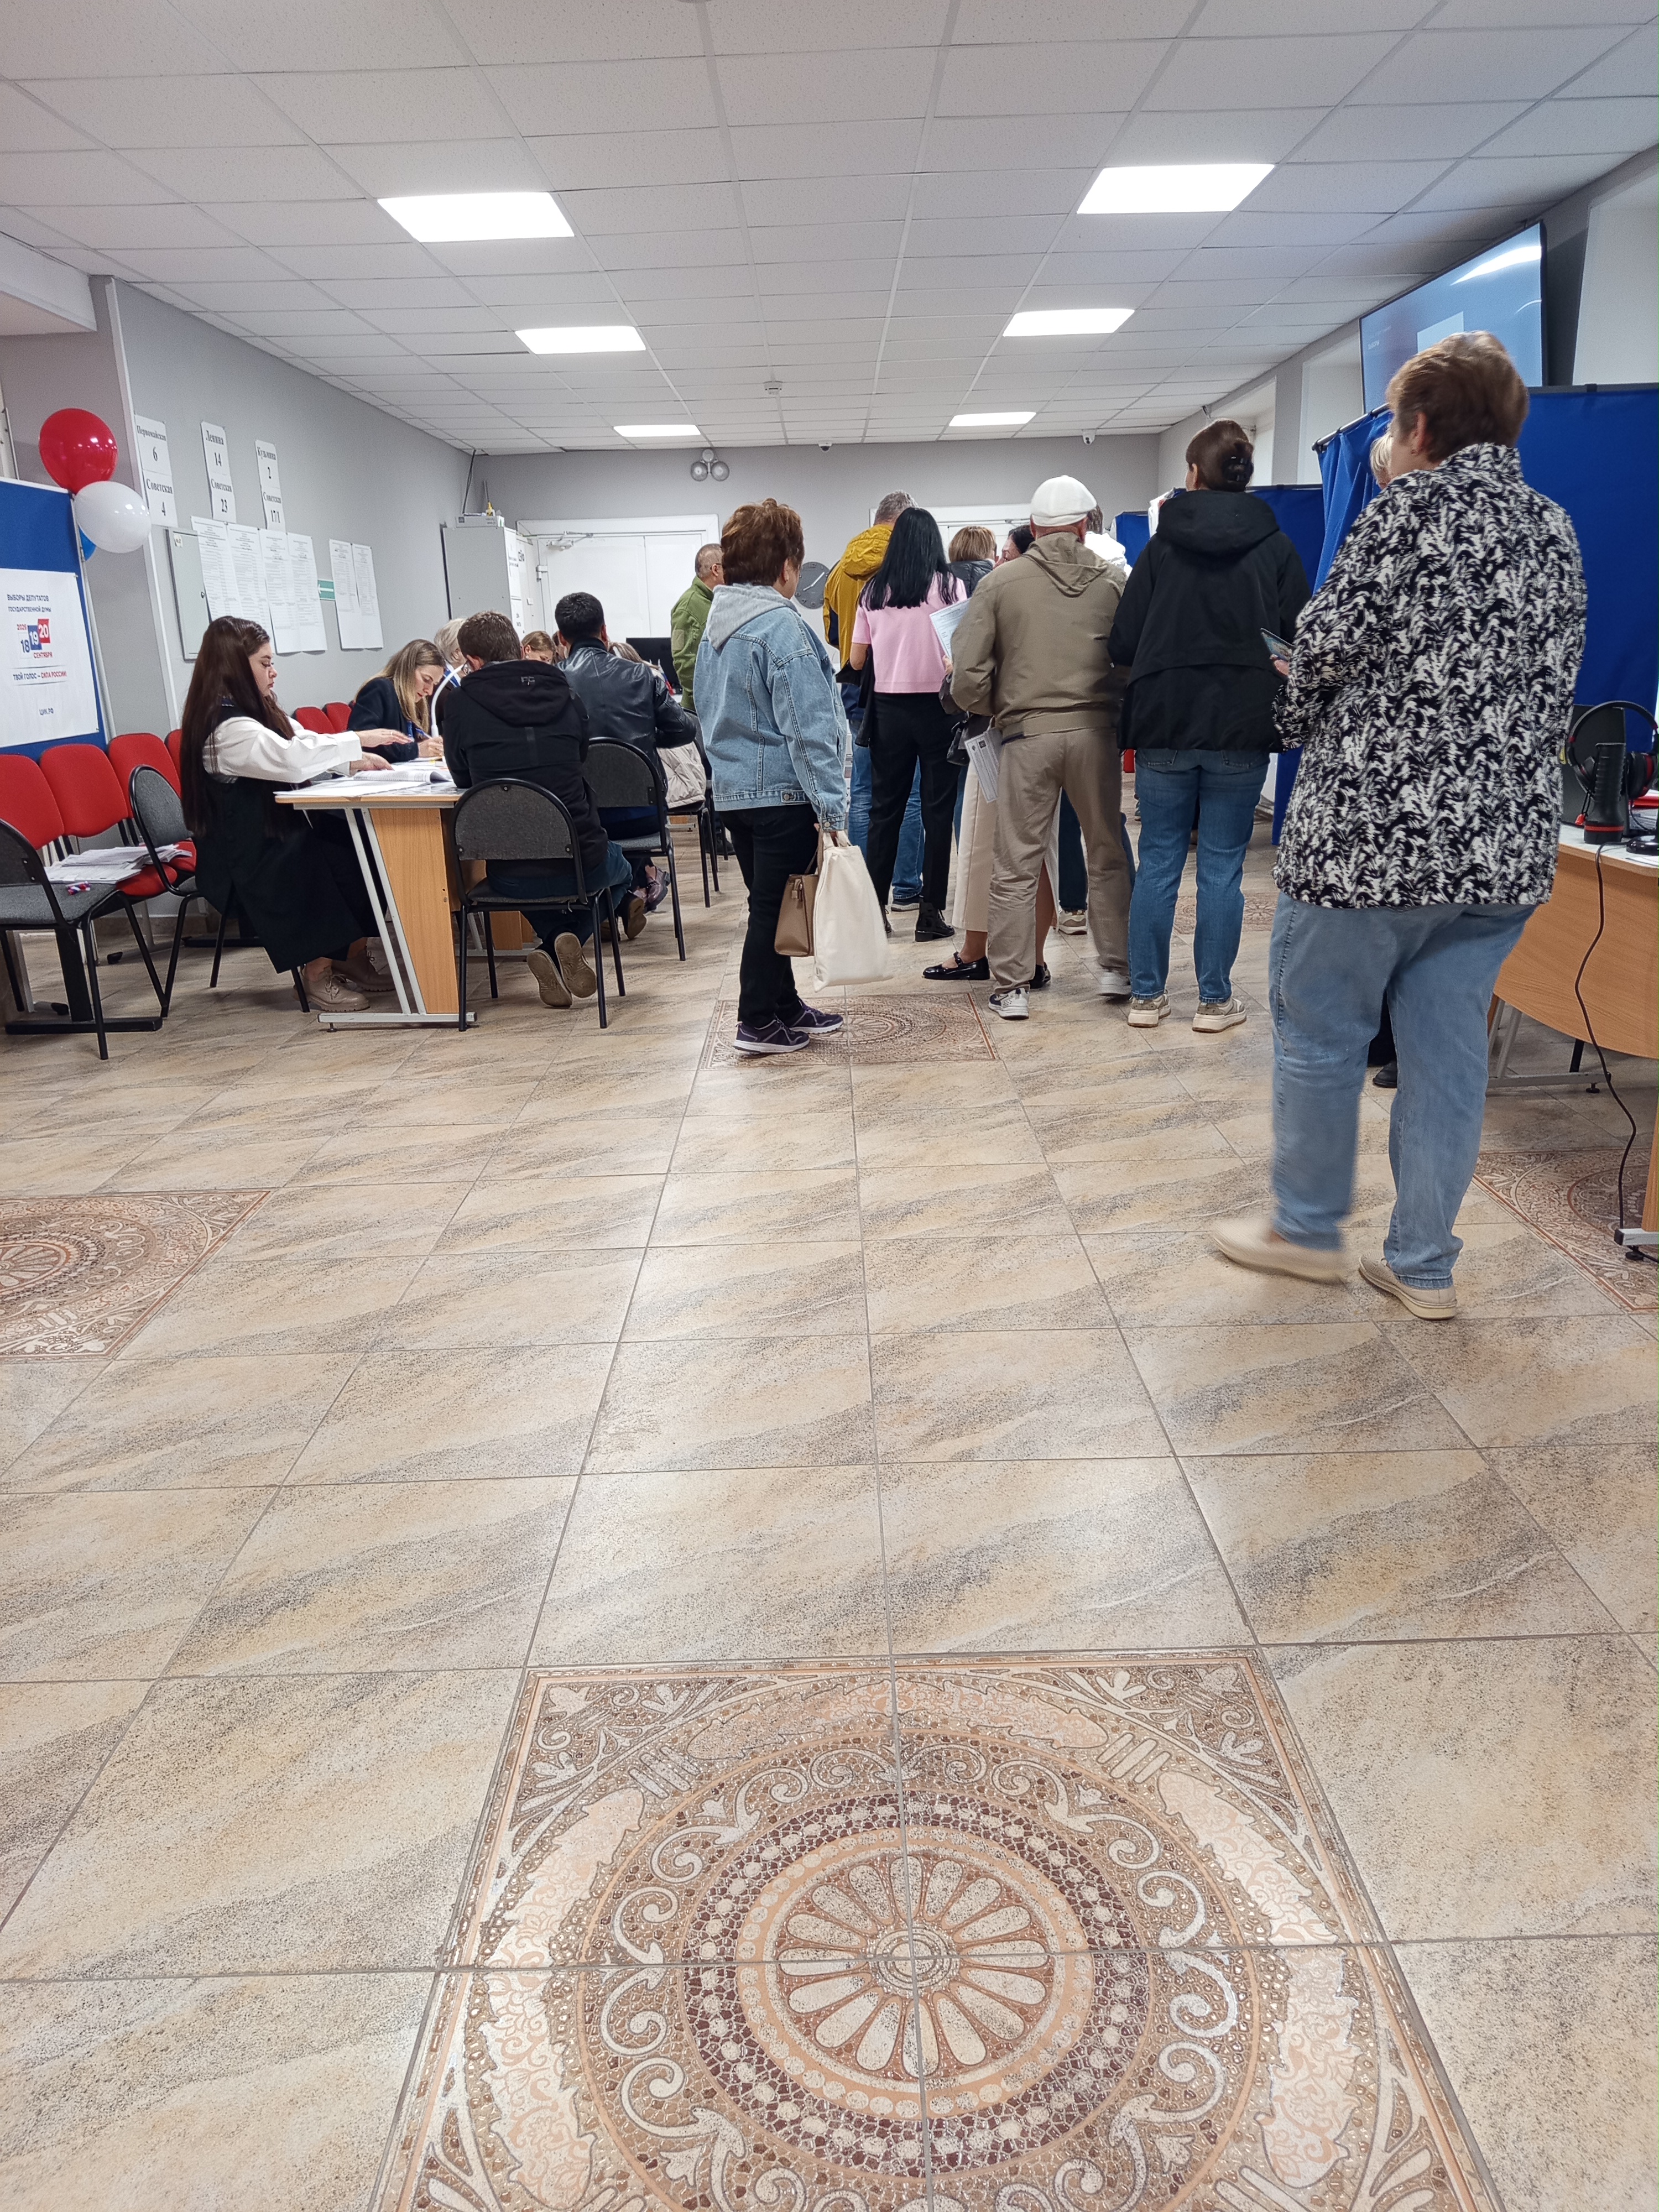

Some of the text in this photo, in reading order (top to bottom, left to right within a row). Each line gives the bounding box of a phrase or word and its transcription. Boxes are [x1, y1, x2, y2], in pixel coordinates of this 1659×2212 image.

[137, 425, 166, 441] Первомайская
[206, 430, 224, 445] Ленина
[153, 446, 158, 462] 6
[214, 452, 222, 467] 14
[257, 446, 276, 460] Кузьмина
[267, 466, 272, 479] 2
[146, 478, 173, 494] Советская
[211, 478, 232, 492] Советская
[263, 492, 281, 504] Советская
[161, 501, 166, 517] 4
[221, 499, 228, 513] 23
[29, 631, 39, 645] 19
[38, 624, 49, 638] 20
[20, 639, 30, 653] 18
[13, 672, 23, 680] ТВОЙ
[39, 707, 54, 716] ЦИК.РФ
